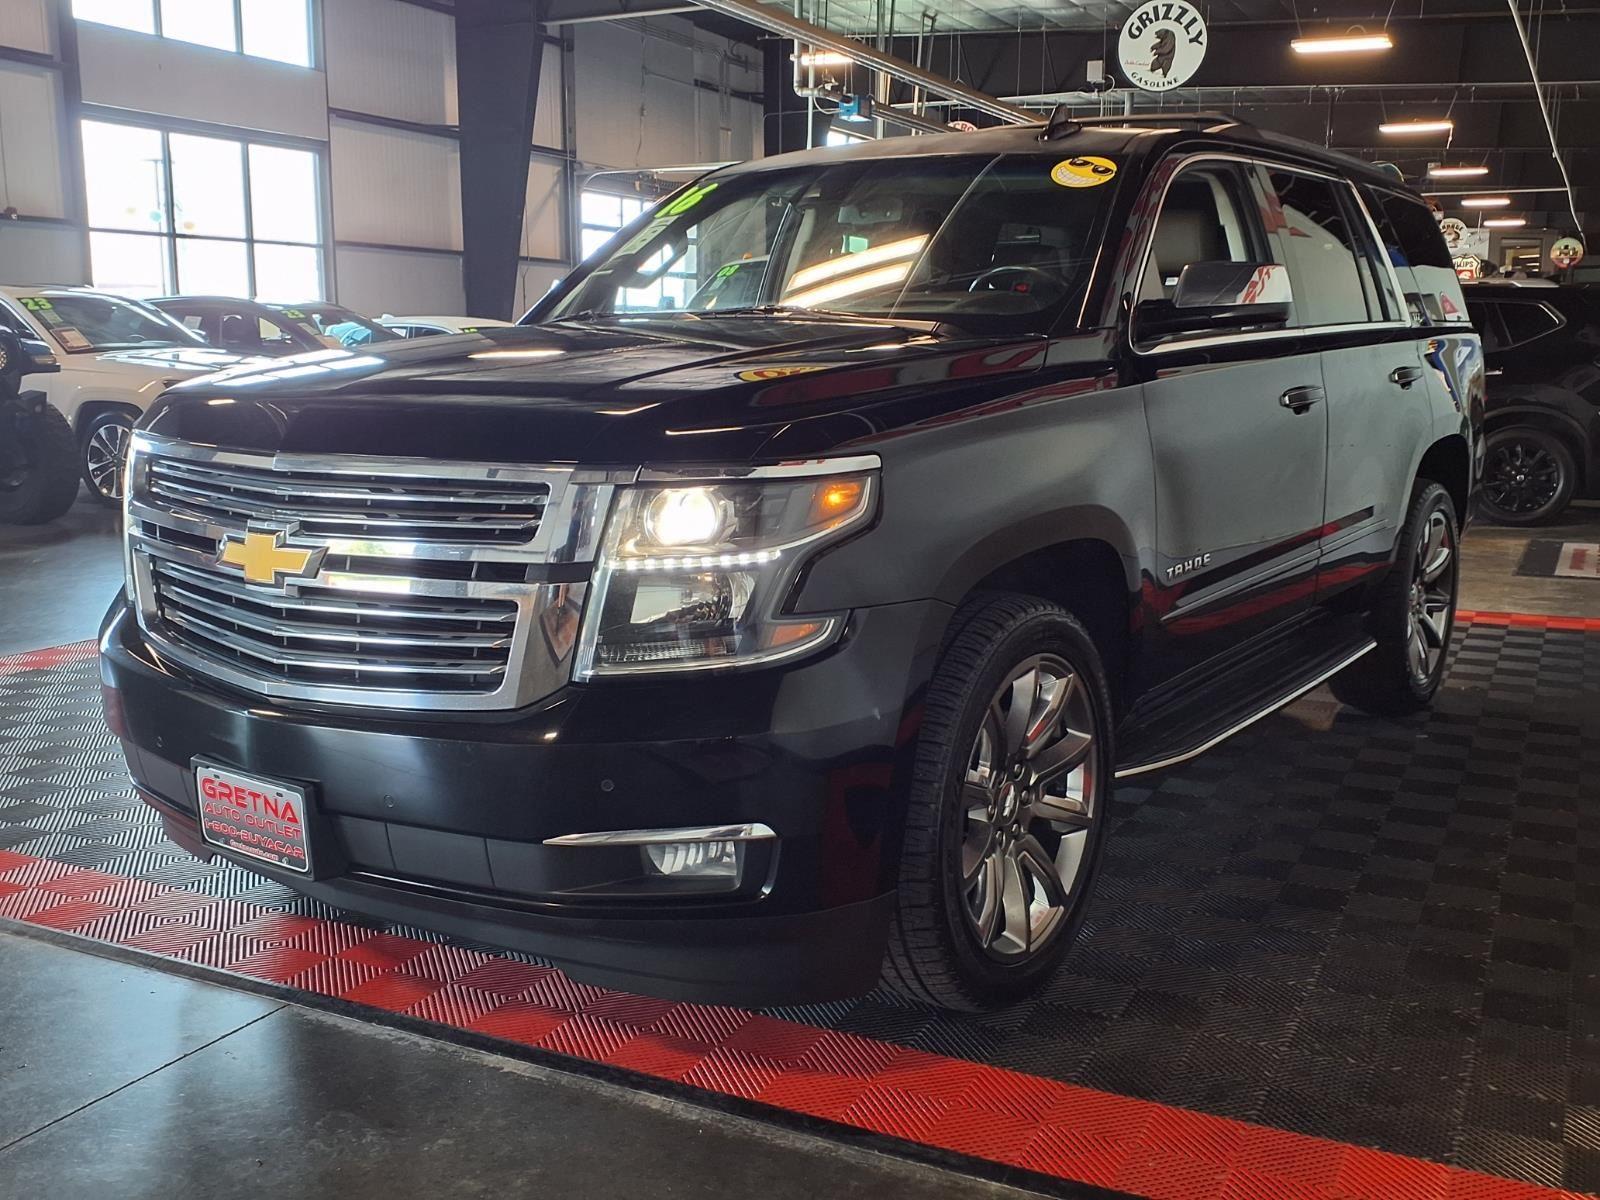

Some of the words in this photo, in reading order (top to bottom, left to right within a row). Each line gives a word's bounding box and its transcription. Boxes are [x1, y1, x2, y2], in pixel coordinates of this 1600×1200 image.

[1128, 3, 1203, 46] GRIZZLY
[1131, 71, 1179, 88] GASOLINE
[20, 297, 53, 311] 23
[1166, 553, 1211, 580] TAHOE
[201, 776, 299, 824] GRETNA
[203, 802, 241, 822] AUTO
[244, 814, 301, 839] OUTLET
[204, 818, 305, 860] 1-800-BUYACAR
